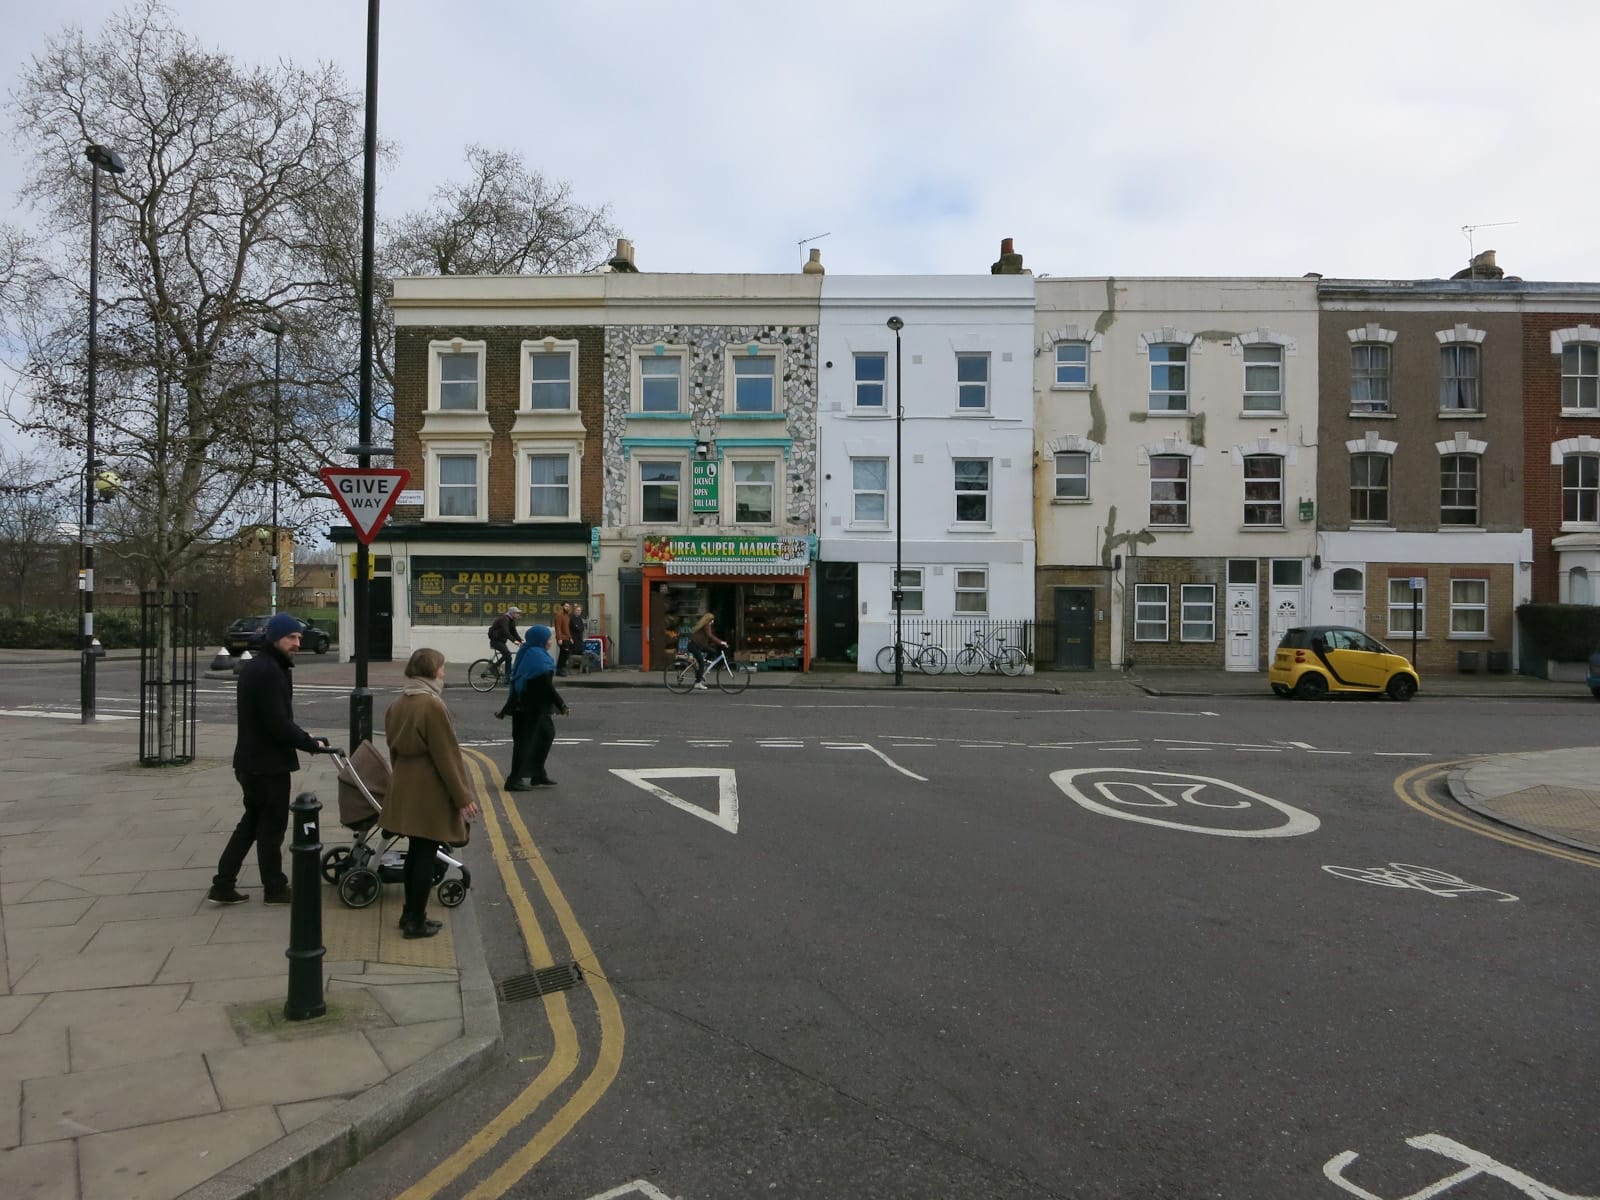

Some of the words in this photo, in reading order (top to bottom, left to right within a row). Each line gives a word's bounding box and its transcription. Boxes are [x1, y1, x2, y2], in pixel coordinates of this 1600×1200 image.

[694, 466, 704, 474] OFF
[339, 478, 389, 494] GIVE
[694, 477, 714, 485] LICENCE
[694, 488, 708, 496] OPEN
[352, 498, 382, 508] WAY
[694, 499, 704, 507] TILL
[705, 499, 717, 507] LATE
[669, 541, 697, 556] URFA
[701, 541, 735, 556] SUPER
[739, 541, 784, 556] MARKET
[458, 573, 549, 584] RADIATOR
[451, 585, 550, 595] CENTRE
